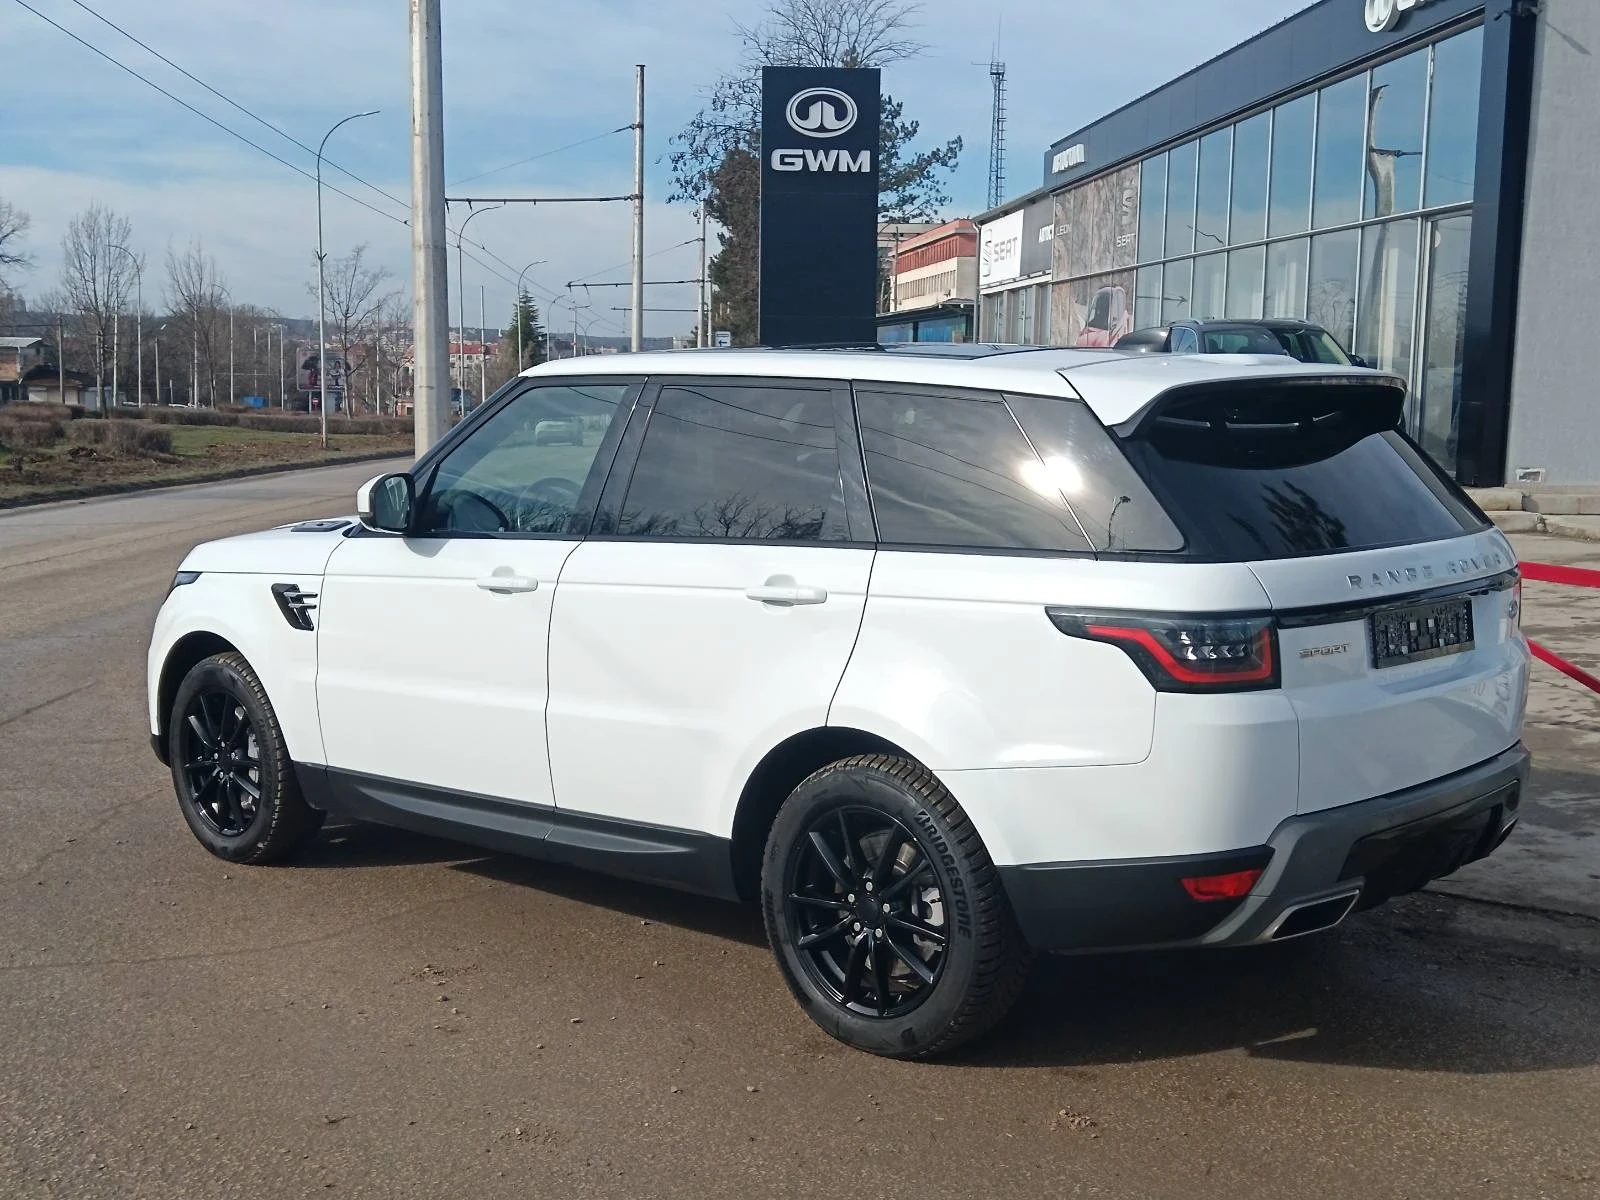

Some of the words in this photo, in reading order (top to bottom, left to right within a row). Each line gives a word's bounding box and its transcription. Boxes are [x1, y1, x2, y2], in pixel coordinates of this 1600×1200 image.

[771, 148, 870, 172] GWM
[993, 237, 1018, 262] SEAT
[1116, 233, 1136, 247] SEAT
[1346, 566, 1432, 590] RANGE
[1300, 643, 1350, 657] SPORT
[916, 809, 972, 938] BRIDGESTONE
